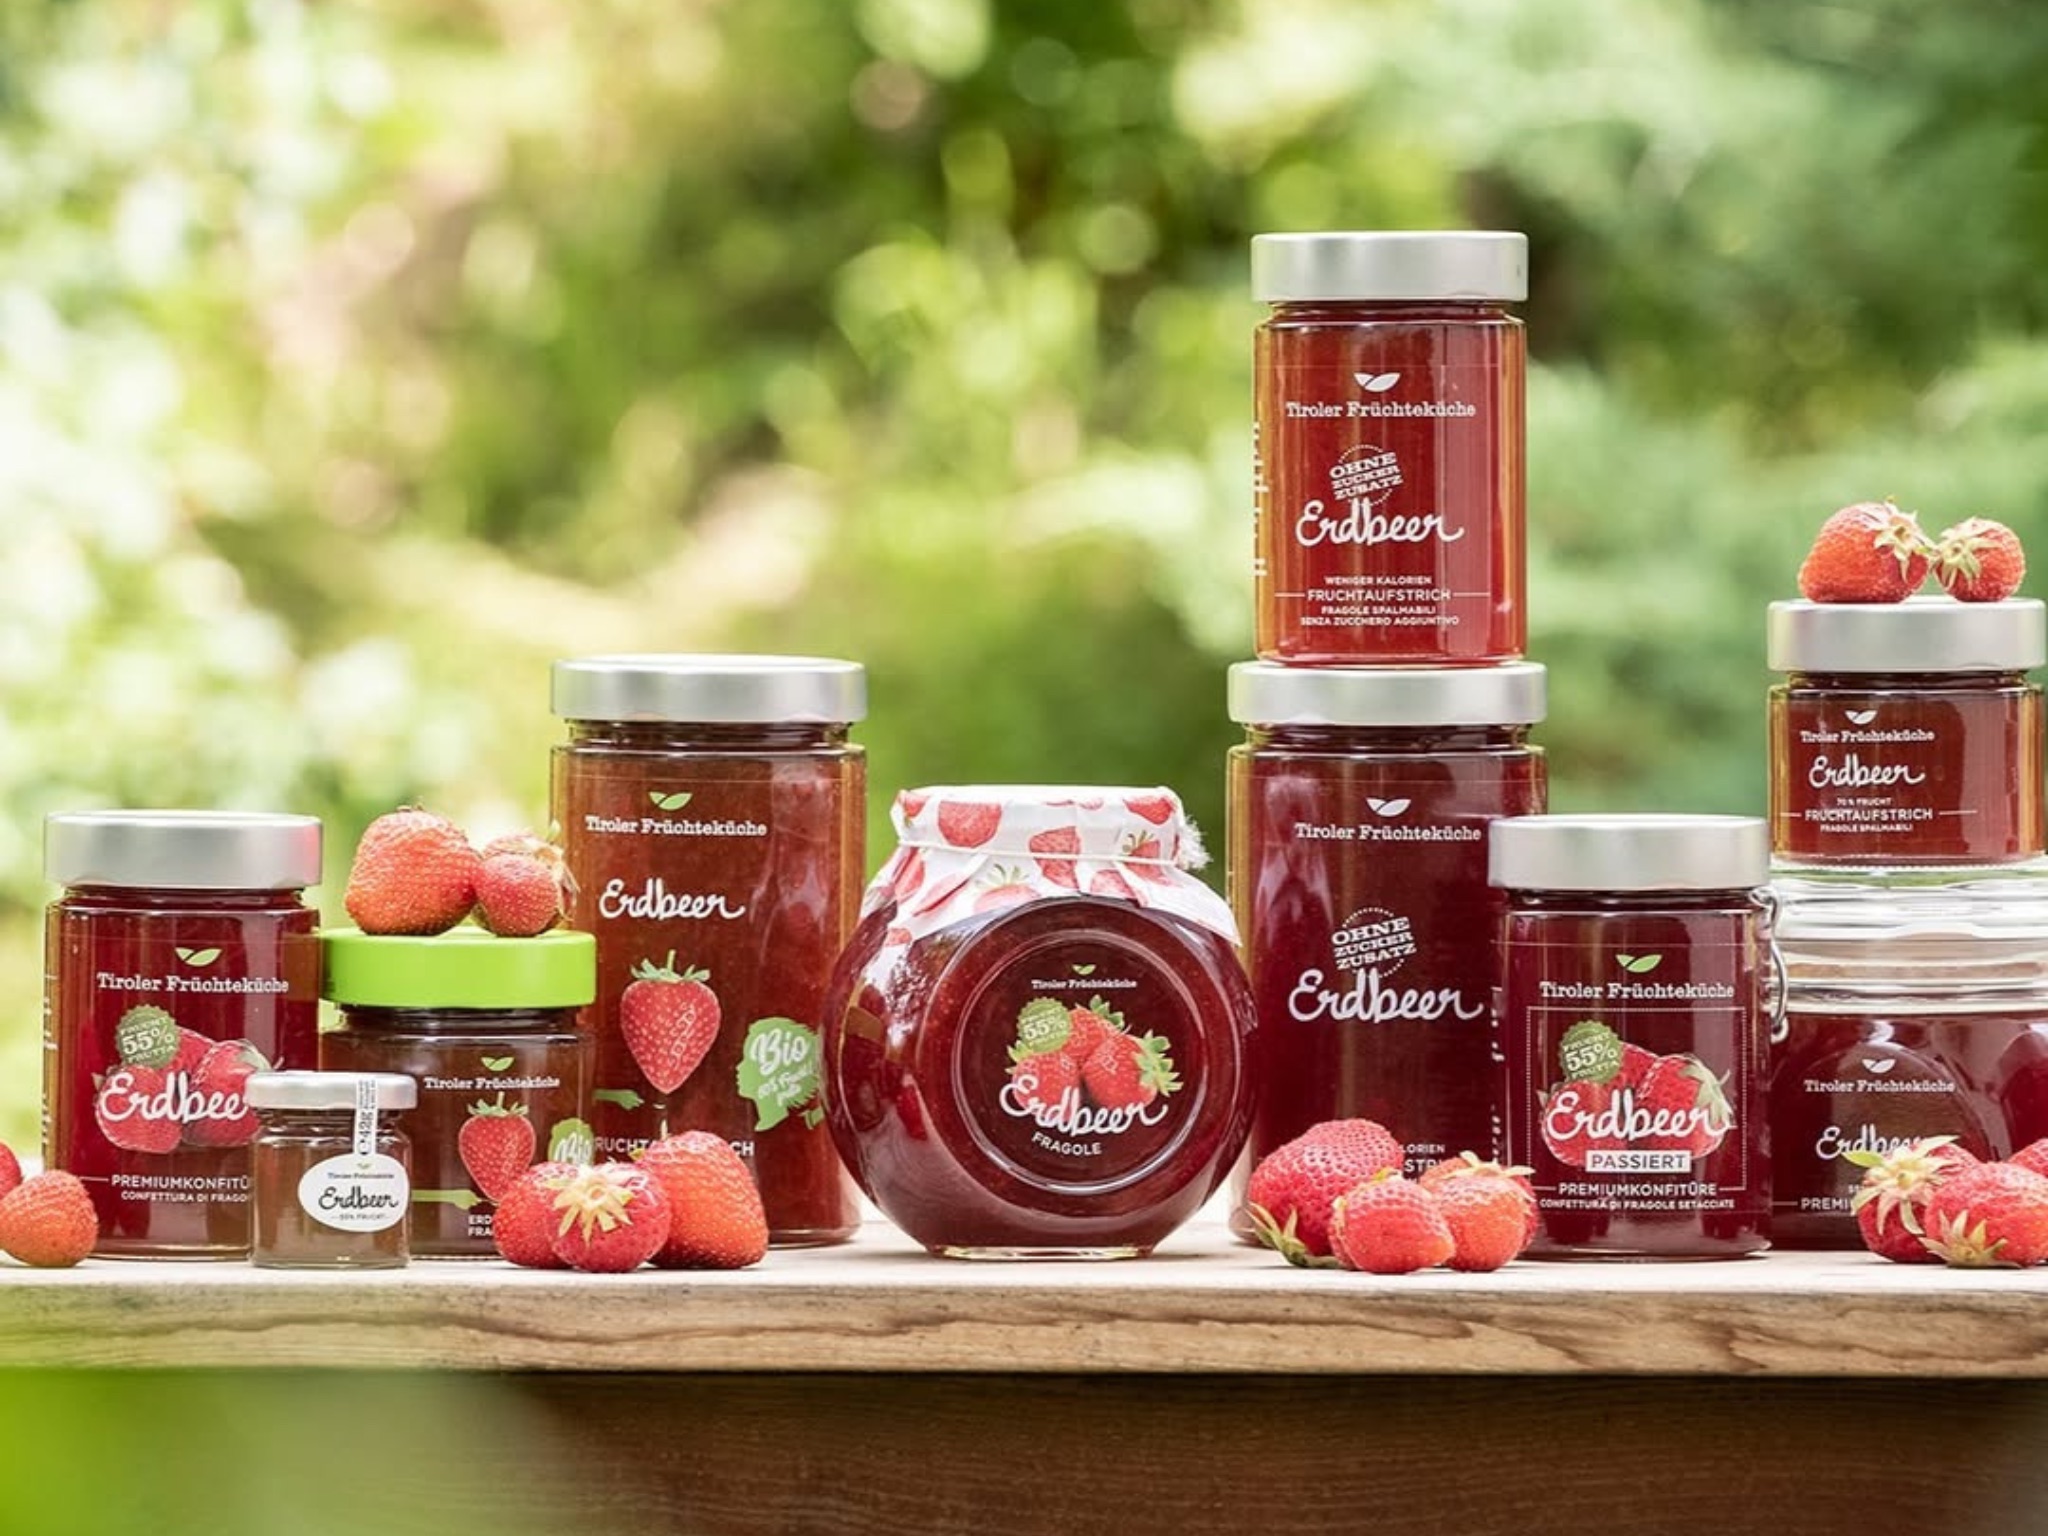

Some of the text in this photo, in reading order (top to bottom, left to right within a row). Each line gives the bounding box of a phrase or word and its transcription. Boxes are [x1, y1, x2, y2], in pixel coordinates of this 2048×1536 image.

[1285, 401, 1476, 418] Tiroler Früchteküche
[1329, 452, 1396, 479] OHNE
[1331, 465, 1401, 489] ZUCKER
[1333, 475, 1404, 500] ZUSATZ
[1296, 497, 1465, 547] Erdbeer
[1324, 575, 1433, 585] WENIGER KALORIEN
[1307, 588, 1451, 601] FRUCHTAUFSTRICH
[1300, 616, 1460, 626] SENZA ZUCCHERO AGGIUNTIVO
[1320, 605, 1436, 615] FRAGOLE SPALMABILI
[1801, 728, 1935, 744] Tiroler Früchteküche
[1809, 753, 1926, 788] Erdbeer
[585, 814, 768, 836] Tiroler Früchteküche
[1804, 808, 1933, 821] FRUCHTAUFSTRICH
[1294, 822, 1481, 841] Tiroler Früchteküche
[599, 877, 746, 920] Erdbeer
[1331, 916, 1411, 946] OHNE
[1333, 931, 1414, 957] ZUCKER
[1336, 943, 1417, 971] ZUSATZ
[96, 972, 289, 993] Tiroler Früchteküche
[1031, 979, 1138, 989] Tiroler Früchteküche
[1539, 981, 1735, 999] Tiroler Früchteküche
[1288, 967, 1484, 1024] Erdbeer
[122, 1025, 175, 1054] 55%
[750, 1028, 810, 1075] Bio
[1565, 1040, 1618, 1071] 55%
[424, 1076, 560, 1090] Tiroler Früchteküche
[1804, 1079, 1955, 1093] Tiroler Früchteküche
[100, 1071, 249, 1124] Erdbee
[1000, 1074, 1169, 1137] Erdbeer
[1546, 1088, 1731, 1141] Erdbeer
[1031, 1131, 1102, 1156] FRAGOLE
[1591, 1154, 1687, 1170] PASSIERT
[111, 1174, 250, 1189] PREMIUMKONFITÜ
[1558, 1181, 1718, 1197] PREMIUMKONFITÜRE
[121, 1190, 195, 1202] CONFETTURA
[197, 1192, 209, 1202] DI
[318, 1185, 399, 1210] Erdbeer
[1540, 1198, 1735, 1210] CONFETTURA DI FRAGOLE SETACCIATE
